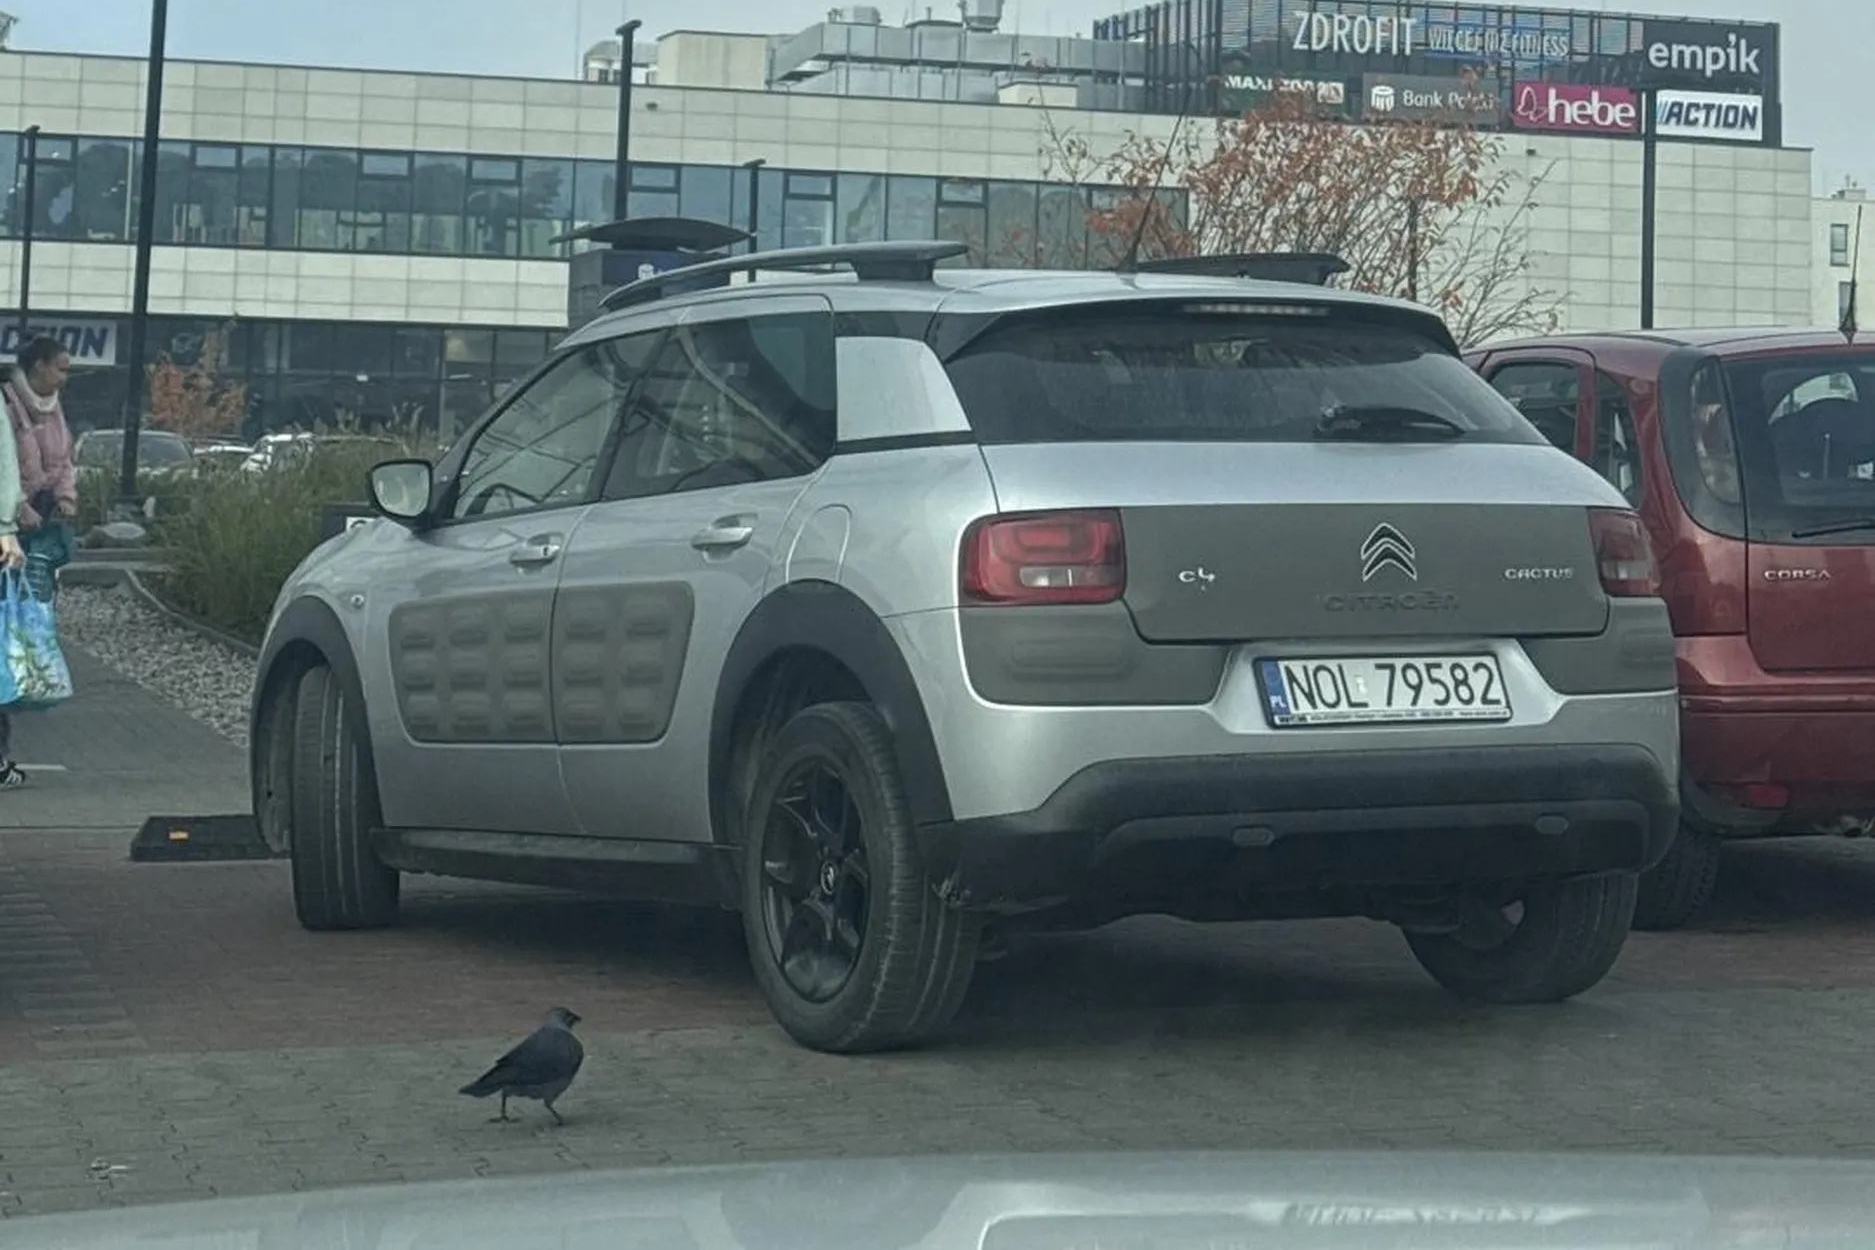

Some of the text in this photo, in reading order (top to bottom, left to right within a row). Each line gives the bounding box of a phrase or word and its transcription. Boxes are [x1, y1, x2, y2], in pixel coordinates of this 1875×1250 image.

[1292, 11, 1417, 56] ZDROFIT
[1648, 33, 1760, 77] empik
[1402, 89, 1443, 108] Bank
[1548, 88, 1636, 127] hebe
[1659, 101, 1759, 130] ACTION
[1504, 568, 1575, 579] CACTUS
[1764, 569, 1831, 581] CORSA
[1284, 662, 1502, 710] NOL 79582
[1269, 695, 1287, 708] PL
